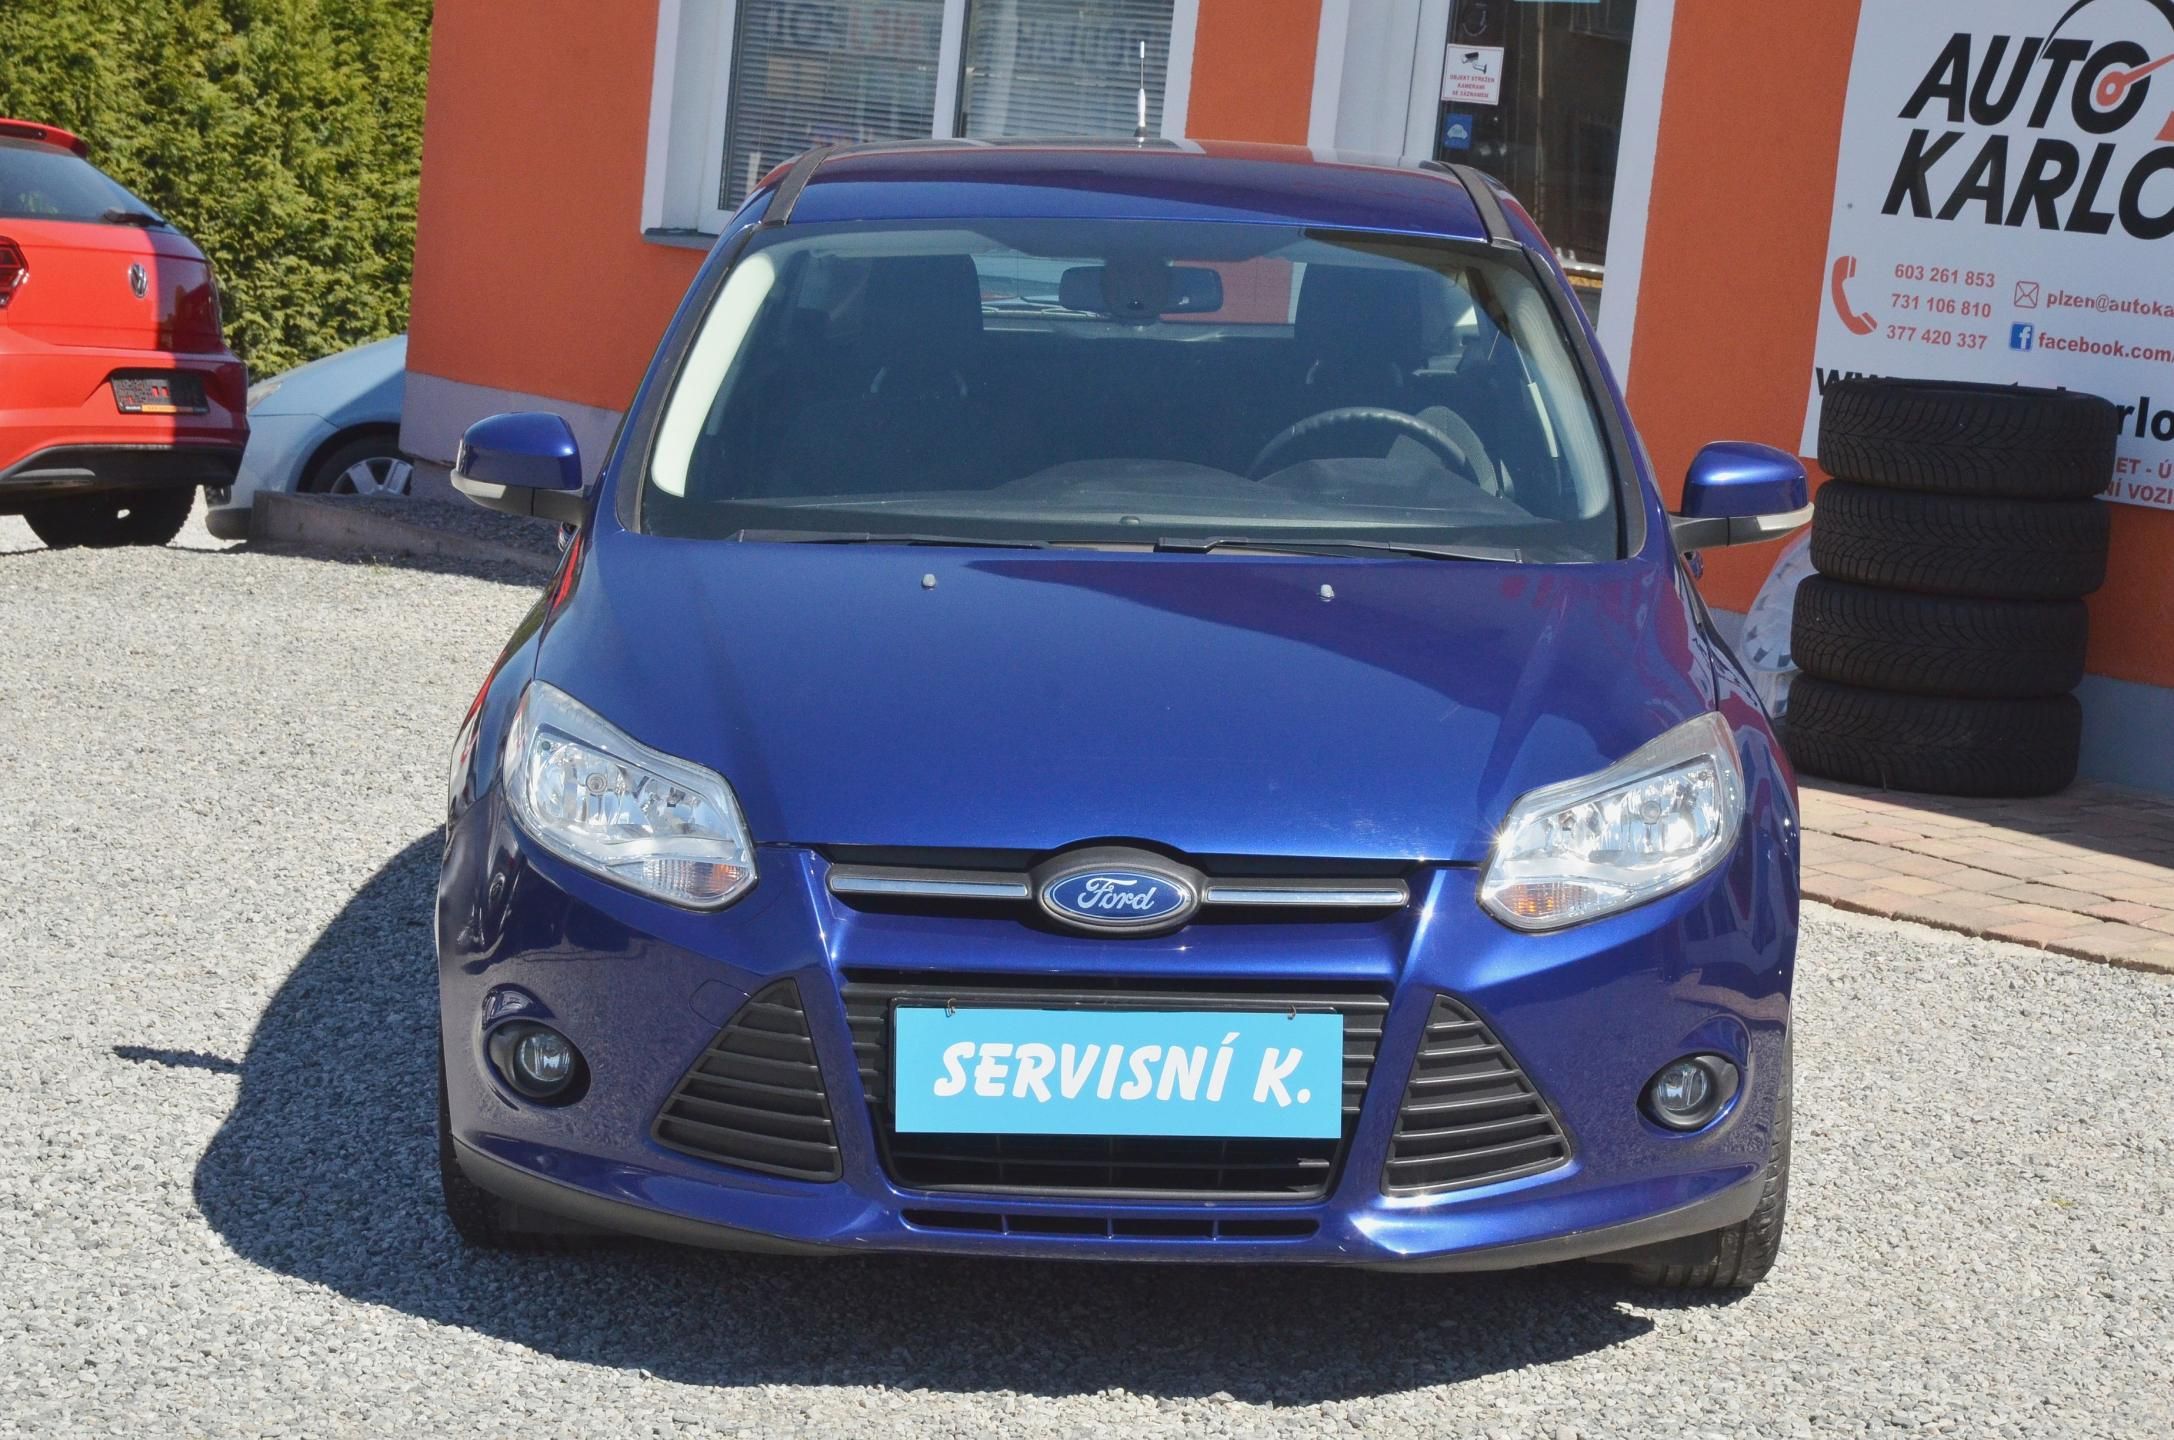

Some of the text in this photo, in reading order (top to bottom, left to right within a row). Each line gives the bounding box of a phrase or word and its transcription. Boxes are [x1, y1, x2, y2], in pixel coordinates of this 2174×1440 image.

[1898, 33, 2151, 134] AUTO
[1881, 129, 2174, 240] KARLO
[1895, 263, 1995, 288] 603 261 853
[1892, 292, 1991, 318] 731 106 810
[1887, 324, 1987, 350] 377 420 337
[1078, 876, 1154, 911] Ford
[934, 1031, 1311, 1107] SERVISNÍ K.
